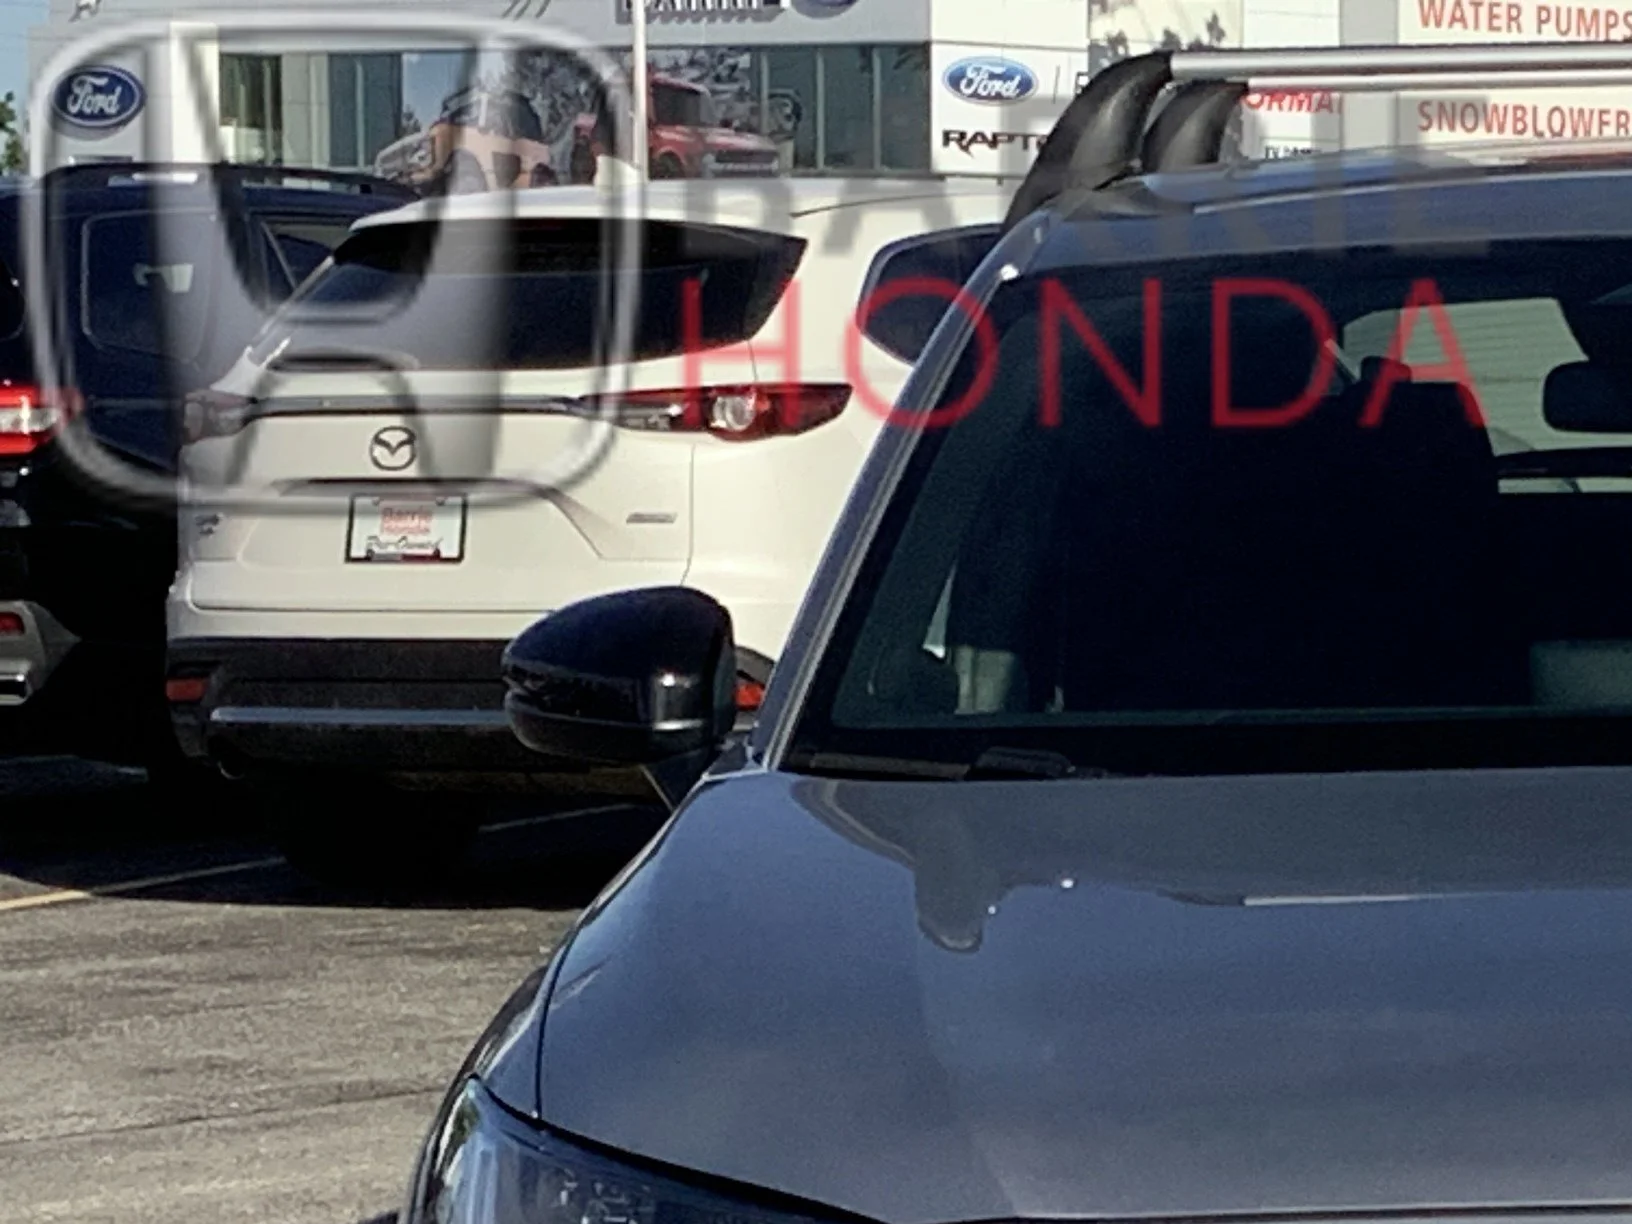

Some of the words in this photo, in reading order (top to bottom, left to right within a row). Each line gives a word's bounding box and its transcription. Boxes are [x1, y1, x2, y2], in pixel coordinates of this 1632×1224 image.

[1418, 0, 1523, 34] WATER
[66, 75, 122, 115] Ford
[958, 63, 1022, 97] Ford
